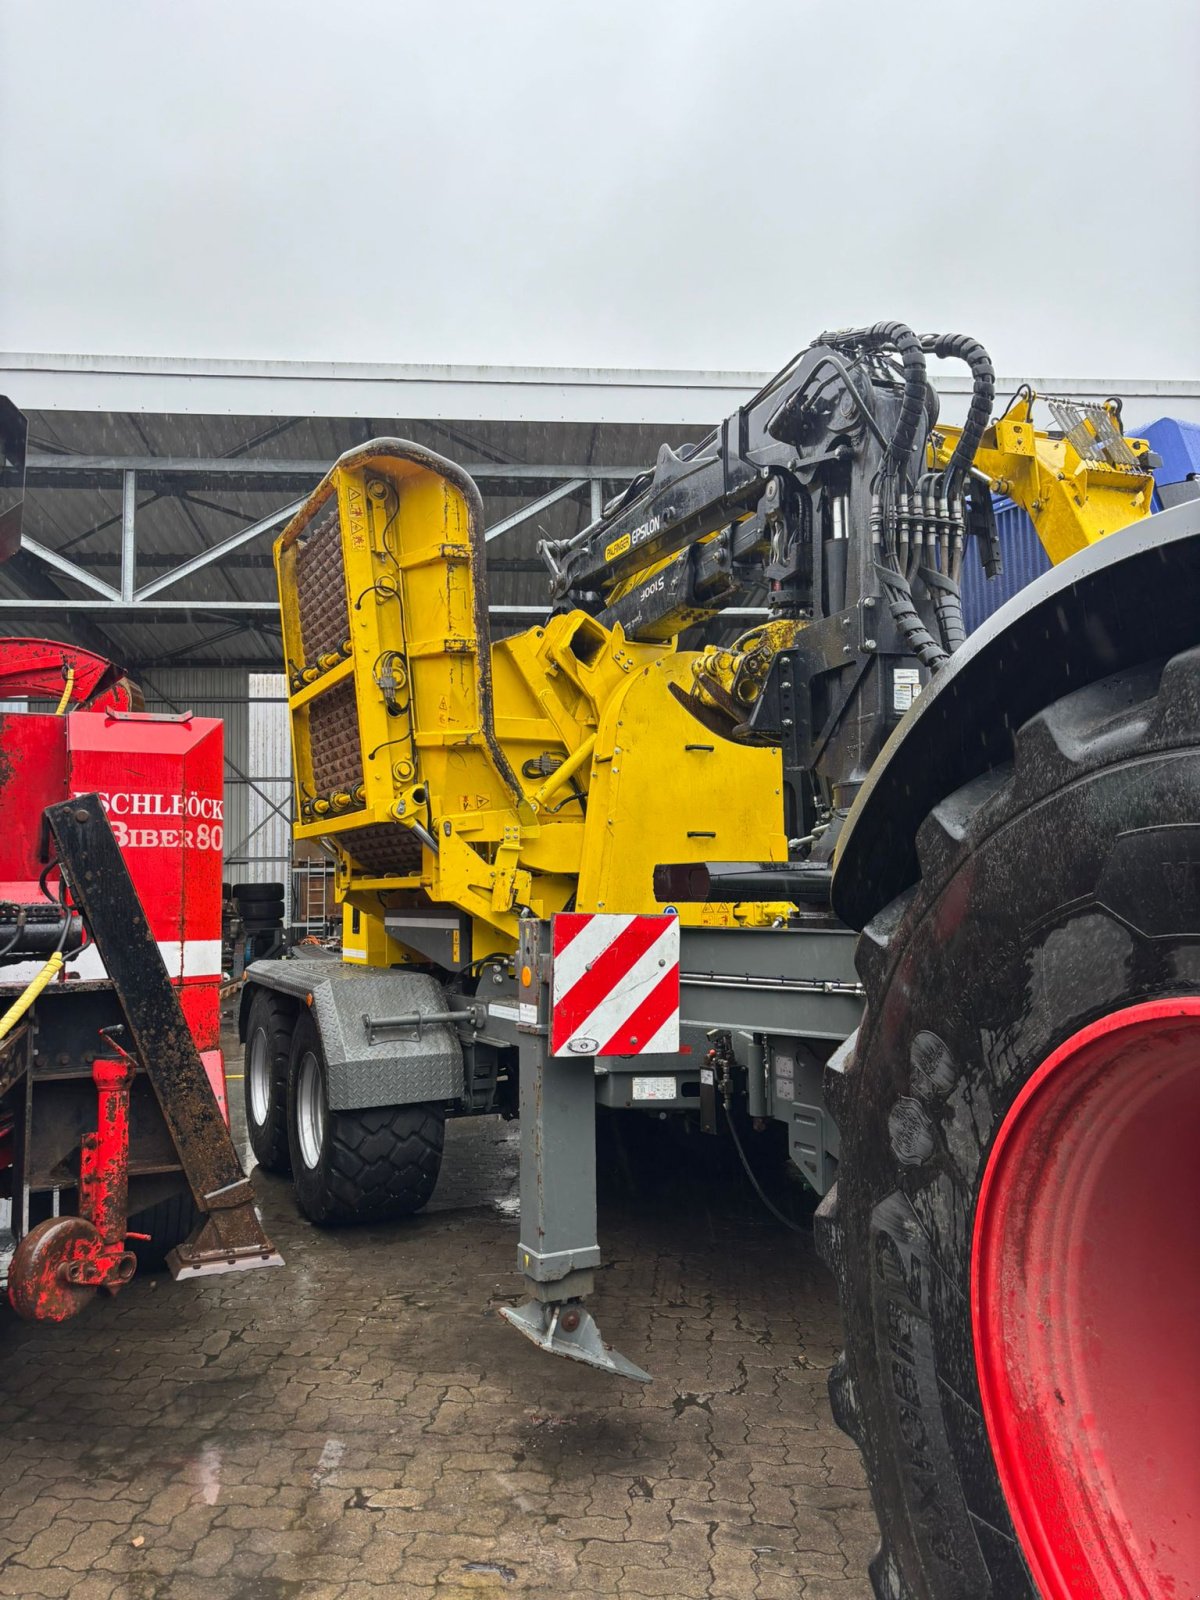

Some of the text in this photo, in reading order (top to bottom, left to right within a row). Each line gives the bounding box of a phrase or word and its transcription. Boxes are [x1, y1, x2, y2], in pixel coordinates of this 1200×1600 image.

[631, 516, 660, 545] EPSILON
[73, 790, 223, 820] SCHLBÖCK
[196, 823, 224, 851] 80
